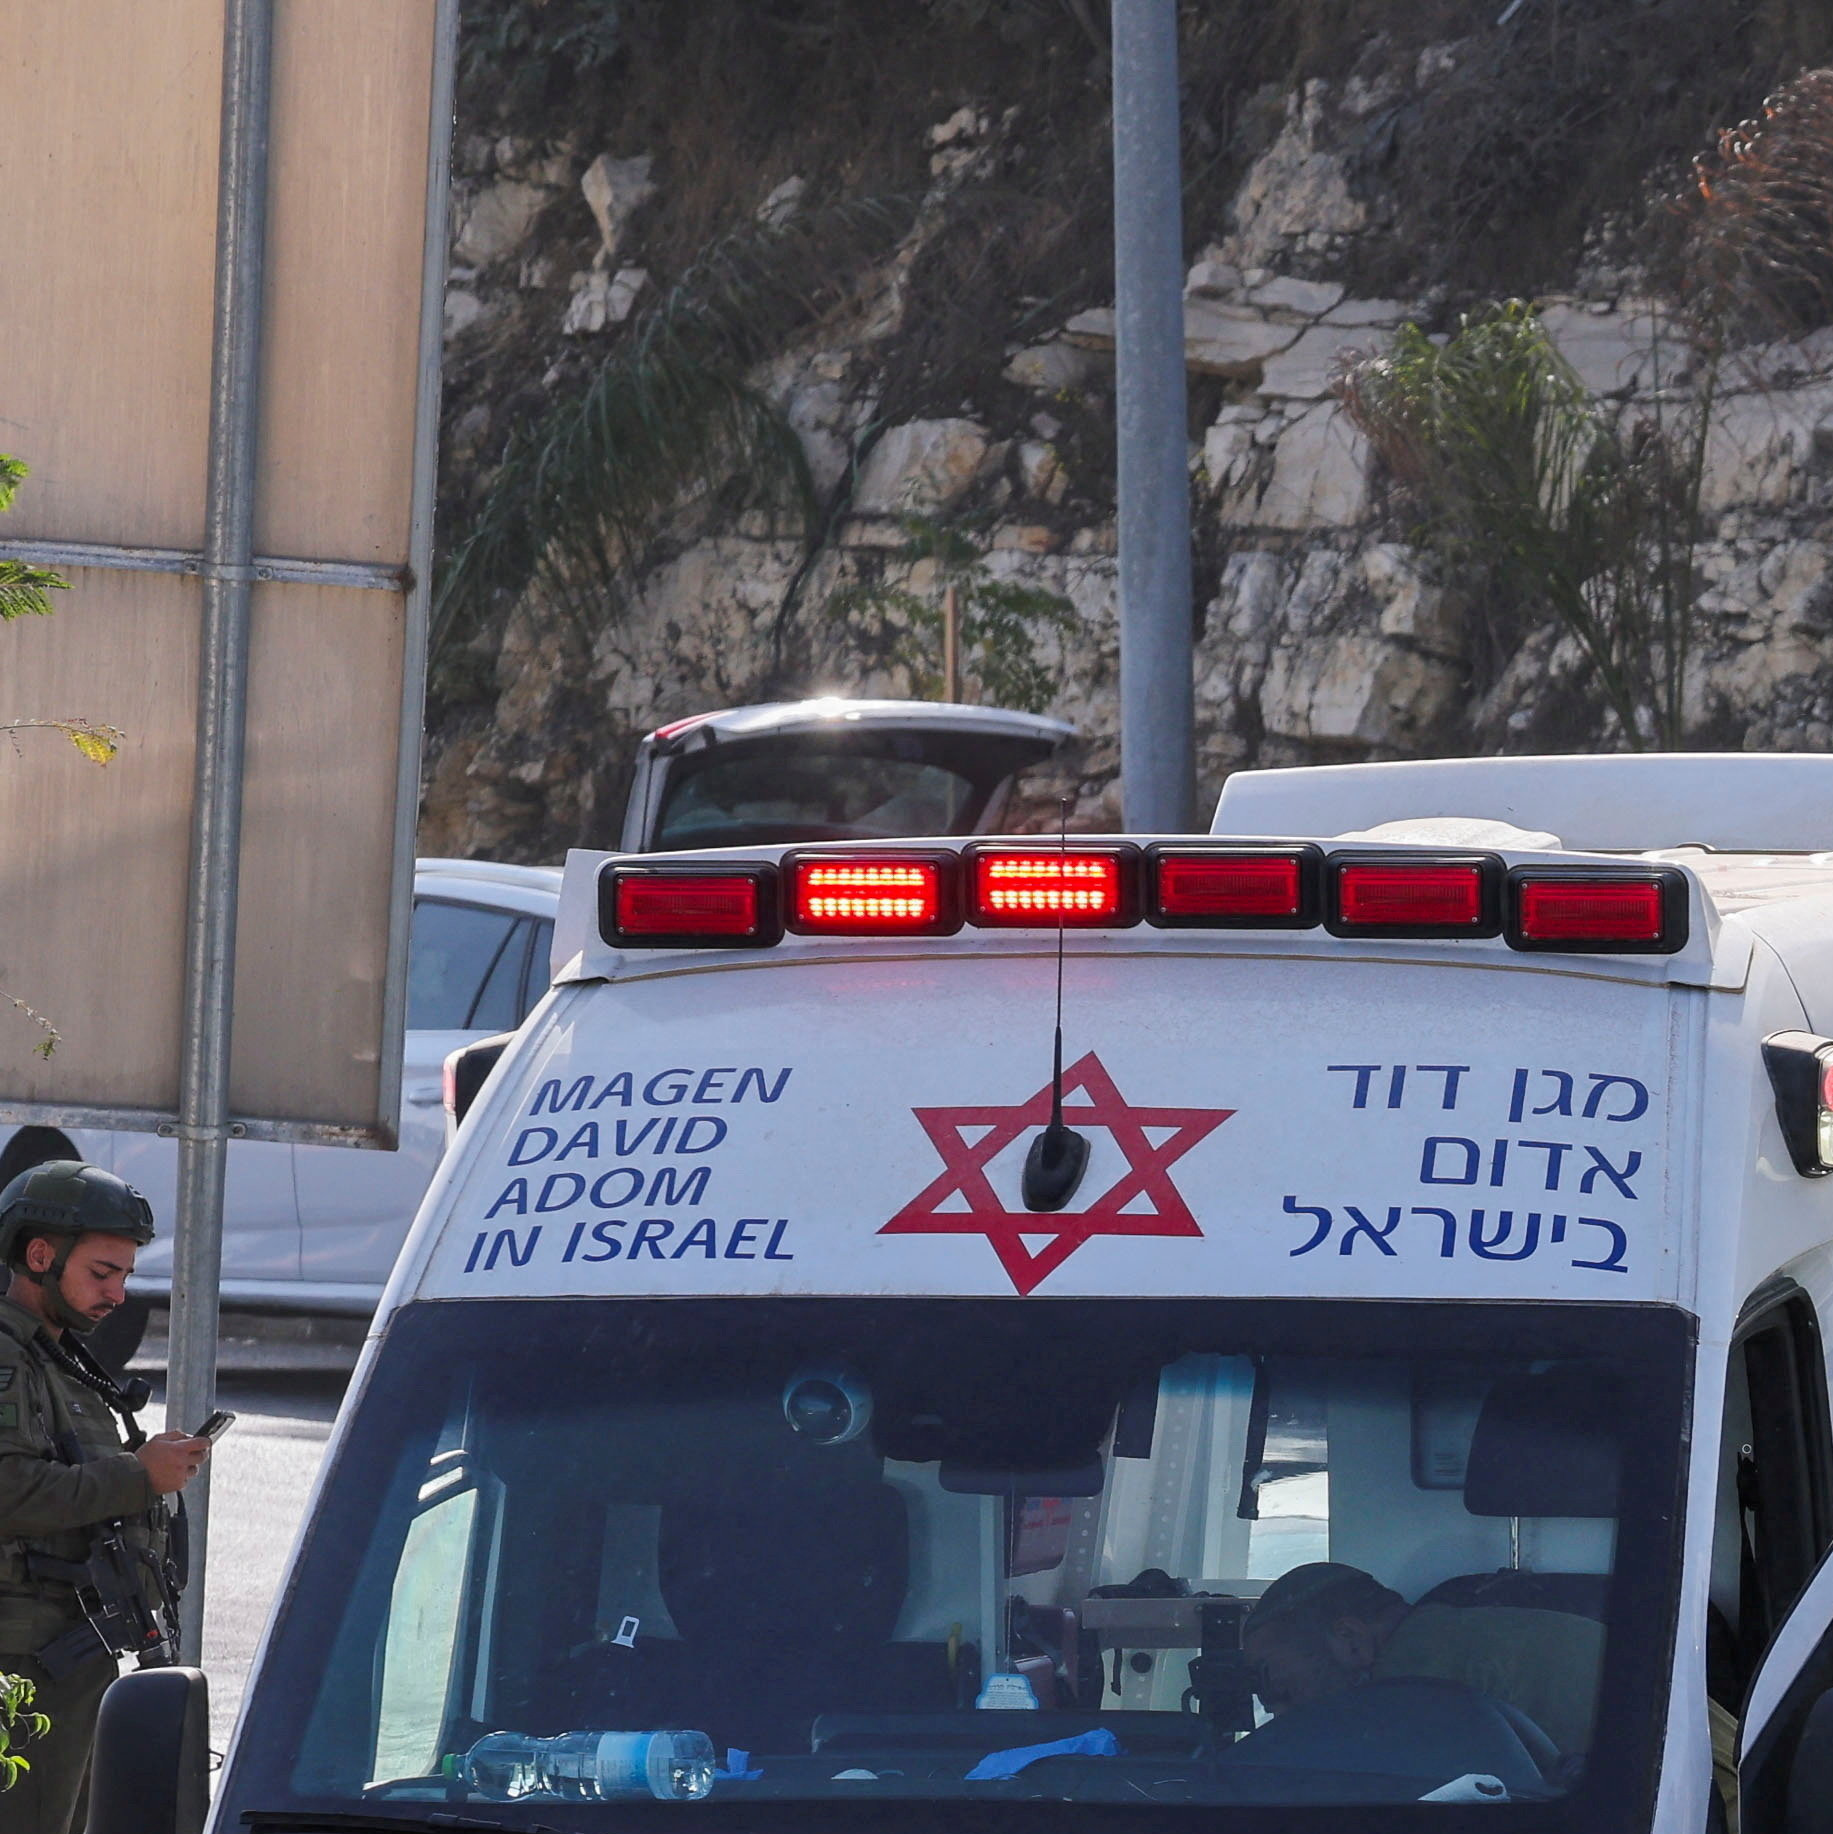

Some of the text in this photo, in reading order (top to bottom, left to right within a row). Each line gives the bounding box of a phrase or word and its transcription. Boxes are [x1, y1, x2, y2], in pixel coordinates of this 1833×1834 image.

[527, 1066, 793, 1117] MAGEN
[1326, 1065, 1650, 1123] מגן דוד
[507, 1116, 729, 1167] DAVID
[1419, 1136, 1642, 1200] אדום
[483, 1166, 712, 1220] ADOM
[463, 1218, 795, 1274] IN ISRAEL
[1282, 1195, 1630, 1274] בישראל
